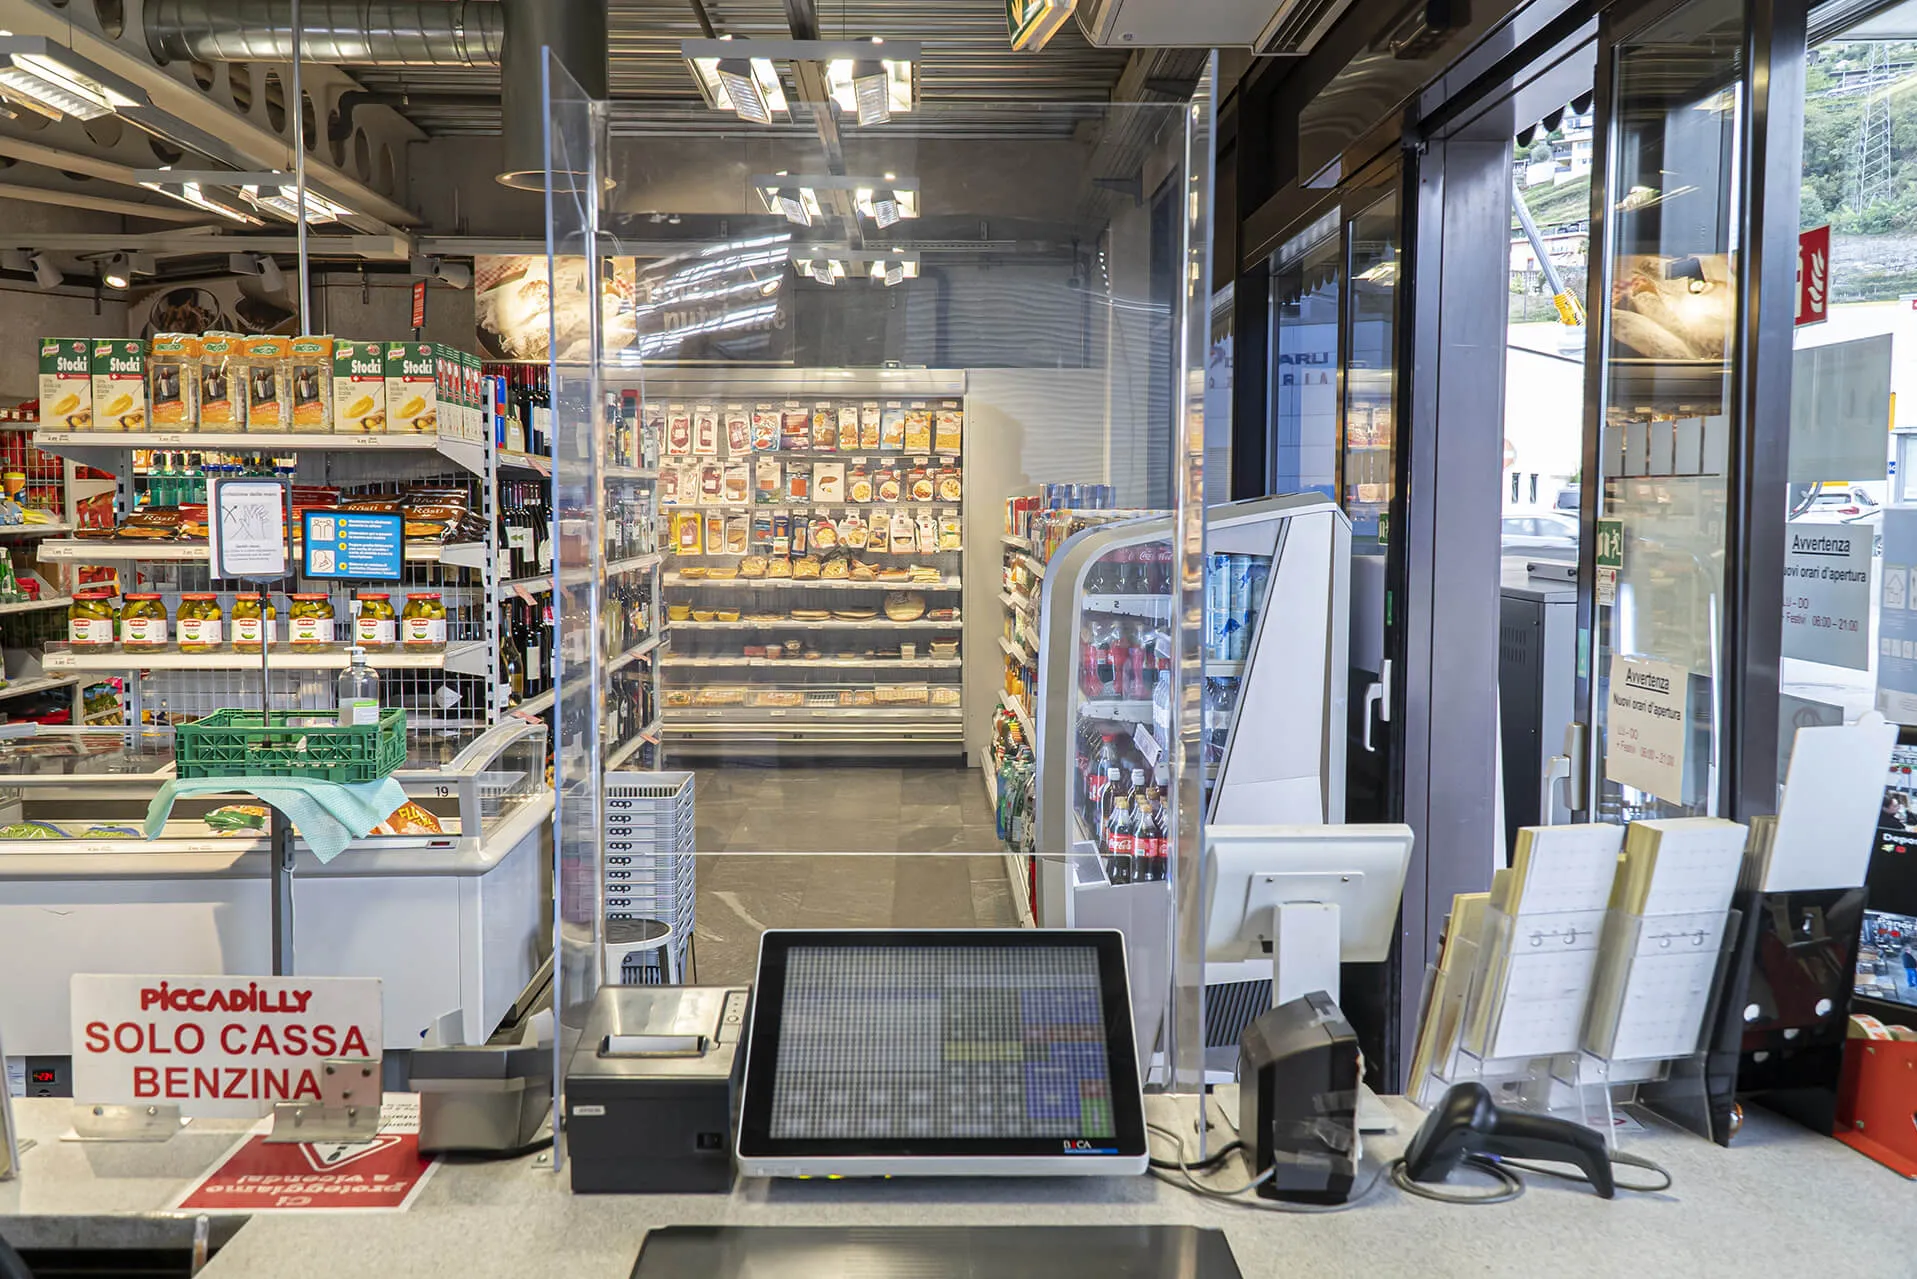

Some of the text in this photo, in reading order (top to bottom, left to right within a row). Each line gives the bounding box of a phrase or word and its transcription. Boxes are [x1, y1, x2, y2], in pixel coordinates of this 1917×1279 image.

[57, 356, 87, 371] Stocki
[110, 356, 140, 372] Stocki
[351, 358, 382, 374] Stocki
[402, 359, 433, 374] Stocki
[1792, 534, 1850, 552] Avvertenza
[1800, 566, 1819, 578] orari
[1625, 667, 1670, 691] Avvertenza
[435, 786, 449, 798] 19
[1883, 833, 1917, 845] Depo
[85, 1021, 370, 1056] SOLO CASSA
[134, 1066, 322, 1100] BENZINA
[236, 1174, 364, 1184] vicenda!
[205, 1181, 408, 1196] proteggiamo
[275, 1195, 312, 1207] Ci
